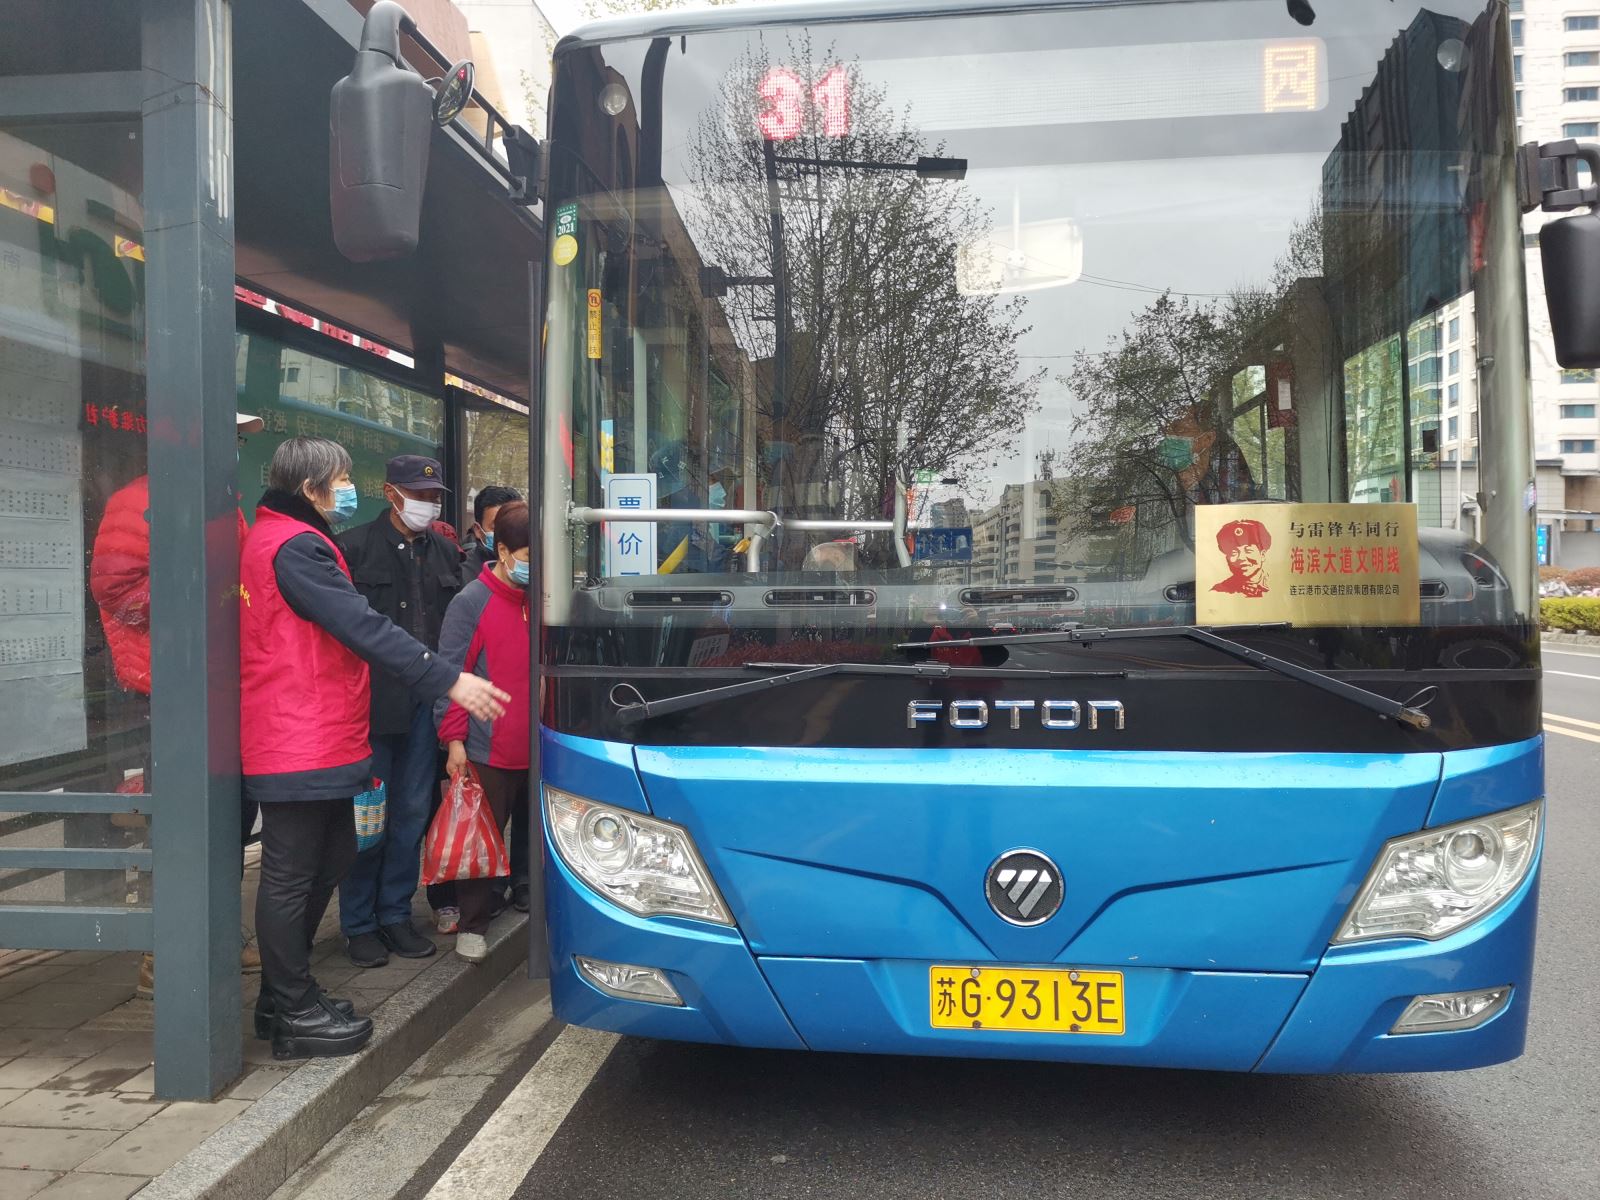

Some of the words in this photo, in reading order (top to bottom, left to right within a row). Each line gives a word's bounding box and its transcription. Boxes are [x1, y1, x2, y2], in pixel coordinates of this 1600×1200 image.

[1263, 45, 1317, 113] 园
[758, 65, 849, 141] 31
[557, 222, 575, 236] 2021
[1288, 521, 1400, 538] 与雷锋车同行
[1290, 545, 1401, 575] 海滨大道文明线
[1289, 583, 1400, 597] 连云港市交通控股集团有限公司
[906, 699, 1125, 730] FOTON
